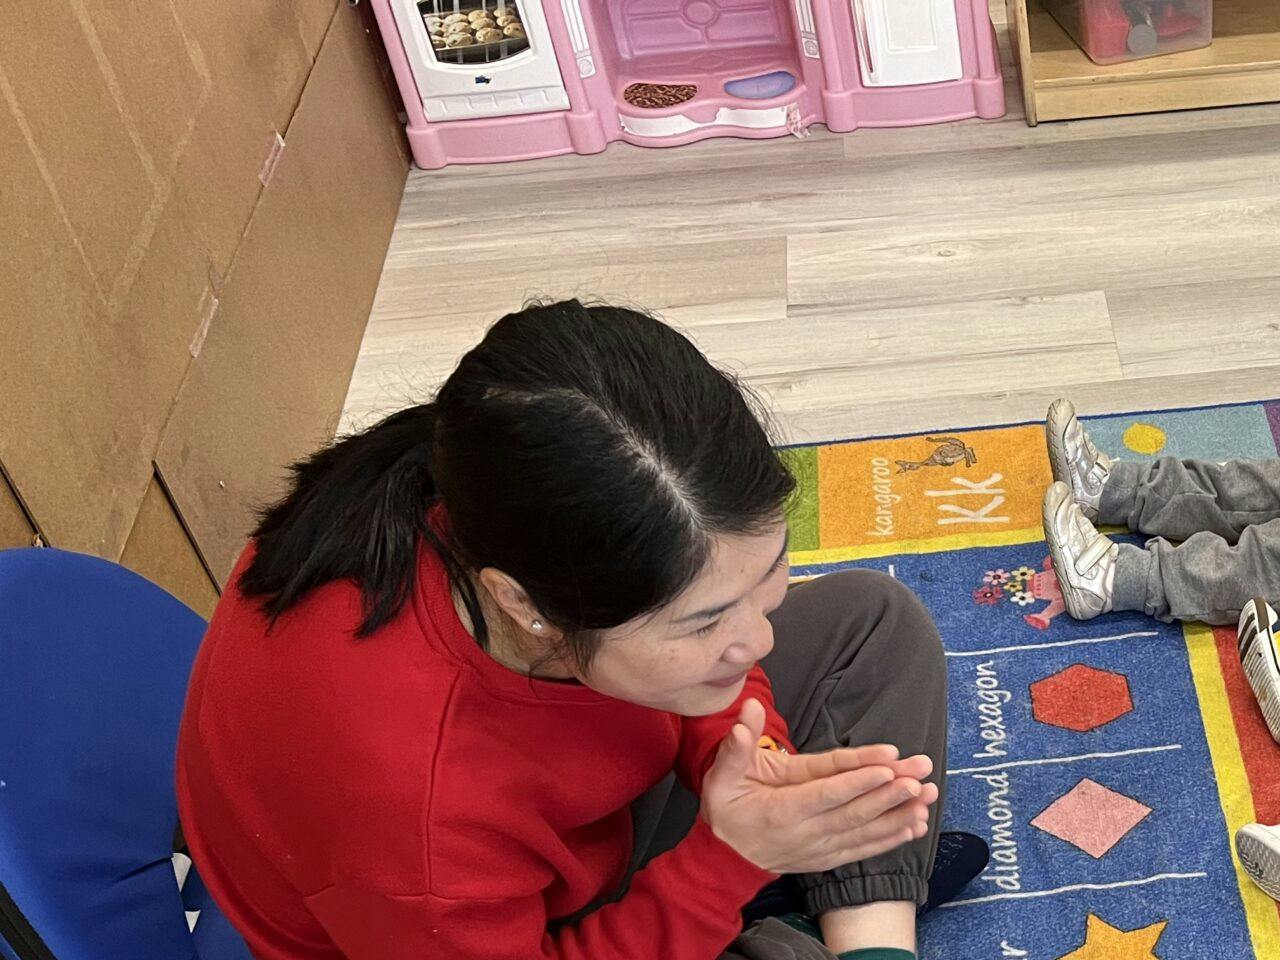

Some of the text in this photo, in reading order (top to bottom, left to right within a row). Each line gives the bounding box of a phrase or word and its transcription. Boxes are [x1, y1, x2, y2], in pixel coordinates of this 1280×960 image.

[867, 457, 901, 537] kangaroo
[924, 472, 1011, 526] Kk
[972, 659, 1012, 758] hexagon
[972, 771, 1021, 891] diamond
